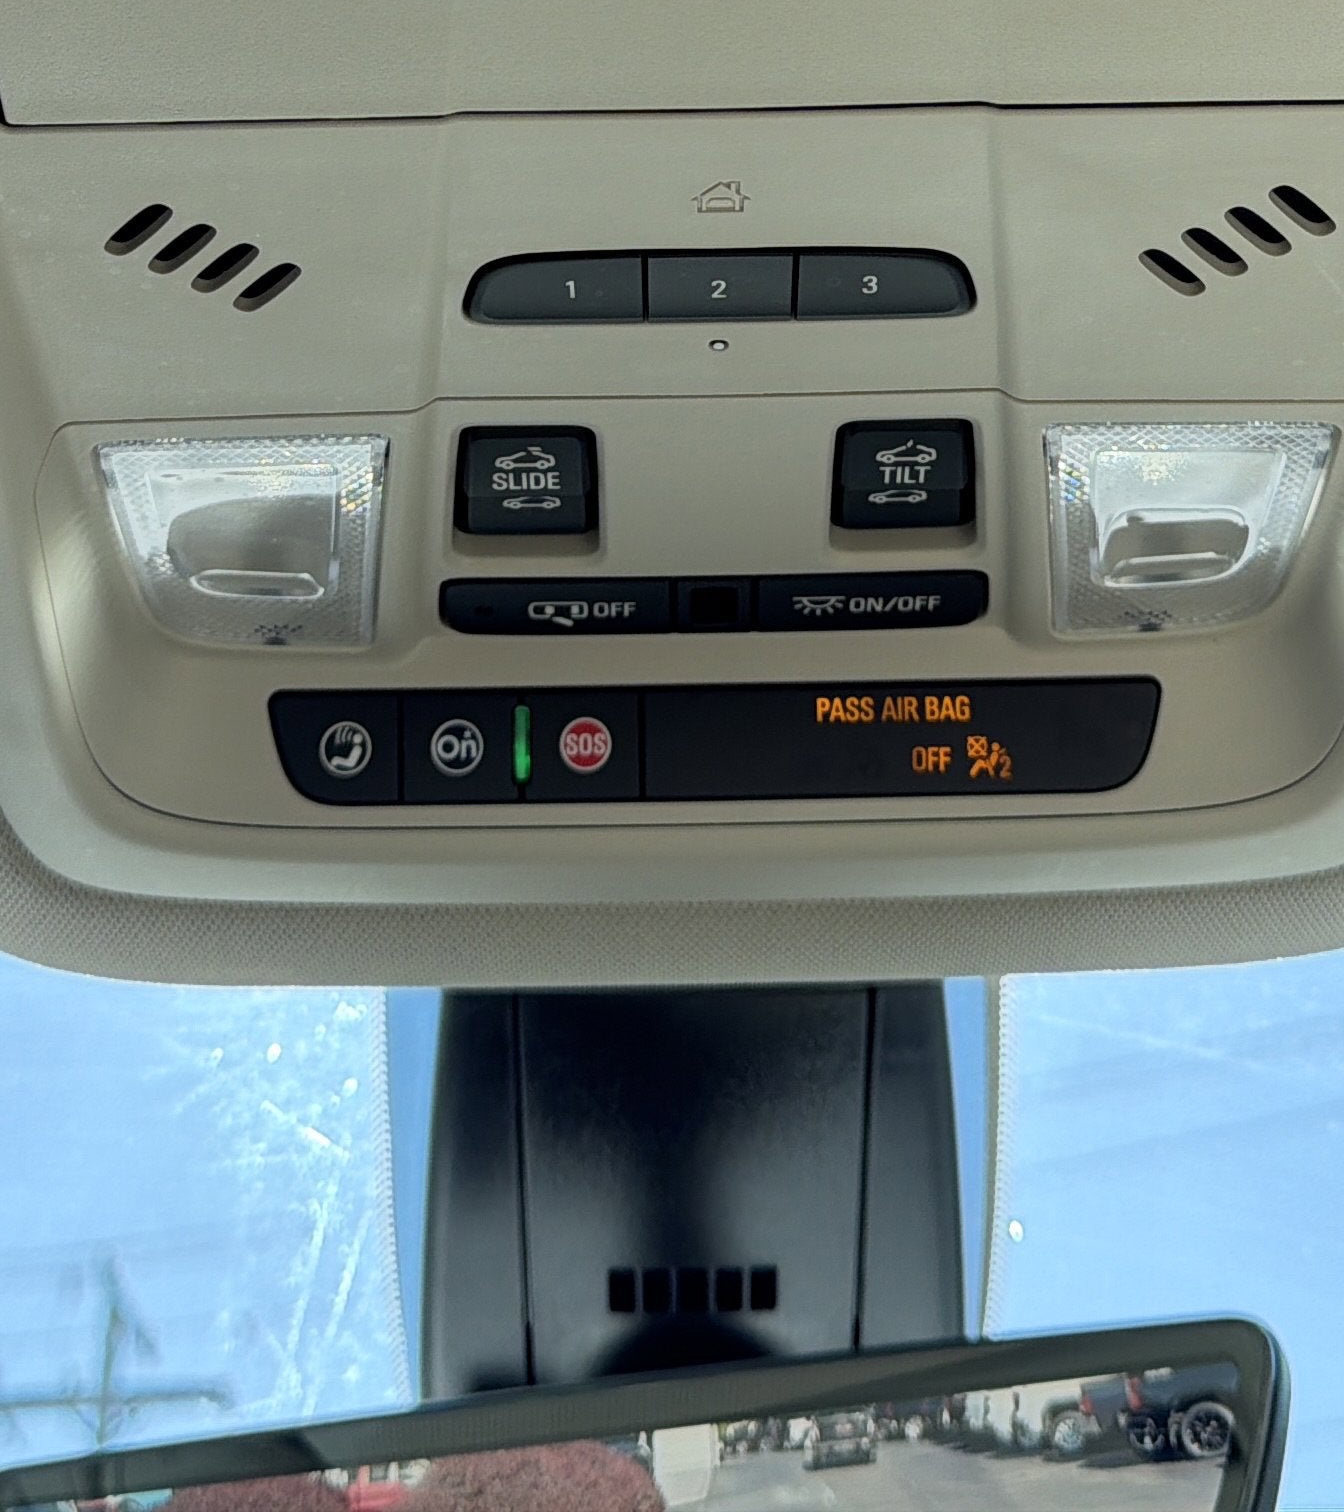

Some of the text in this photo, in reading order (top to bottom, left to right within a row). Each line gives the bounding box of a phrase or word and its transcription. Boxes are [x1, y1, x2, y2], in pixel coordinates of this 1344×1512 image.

[565, 280, 576, 299] 1
[710, 279, 727, 299] 2
[861, 275, 878, 295] 3
[492, 471, 561, 491] SLIDE
[879, 465, 932, 485] TILT
[593, 601, 637, 618] OFF
[849, 595, 941, 613] ON/OFF
[816, 694, 971, 722] PASS AIR BAG
[565, 732, 607, 756] SOS
[912, 746, 952, 773] OFF
